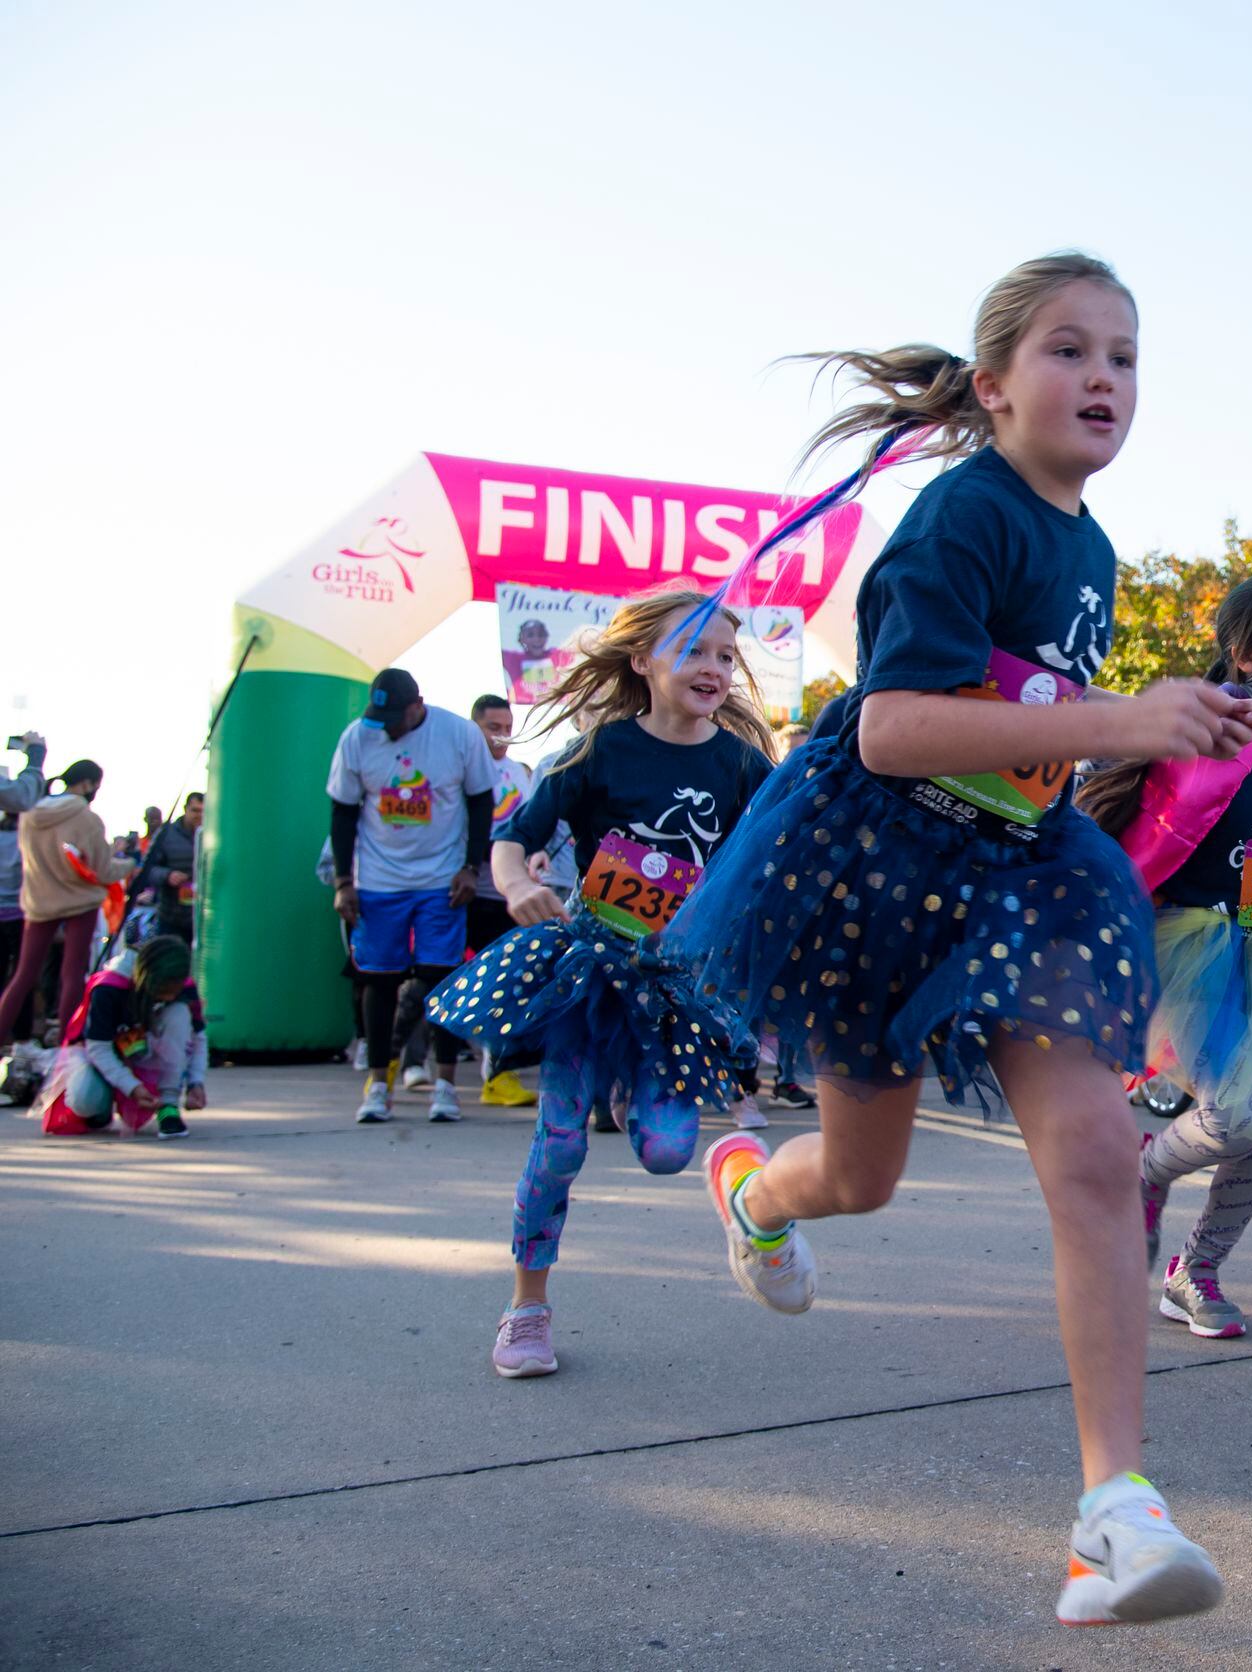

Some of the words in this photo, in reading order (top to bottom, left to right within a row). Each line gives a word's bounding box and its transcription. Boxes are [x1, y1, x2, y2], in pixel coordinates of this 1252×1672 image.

[477, 479, 824, 585] FINISH
[312, 563, 379, 584] Girls
[346, 585, 395, 603] run
[385, 800, 427, 815] 1469
[923, 784, 956, 806] RITE
[952, 802, 979, 820] AID
